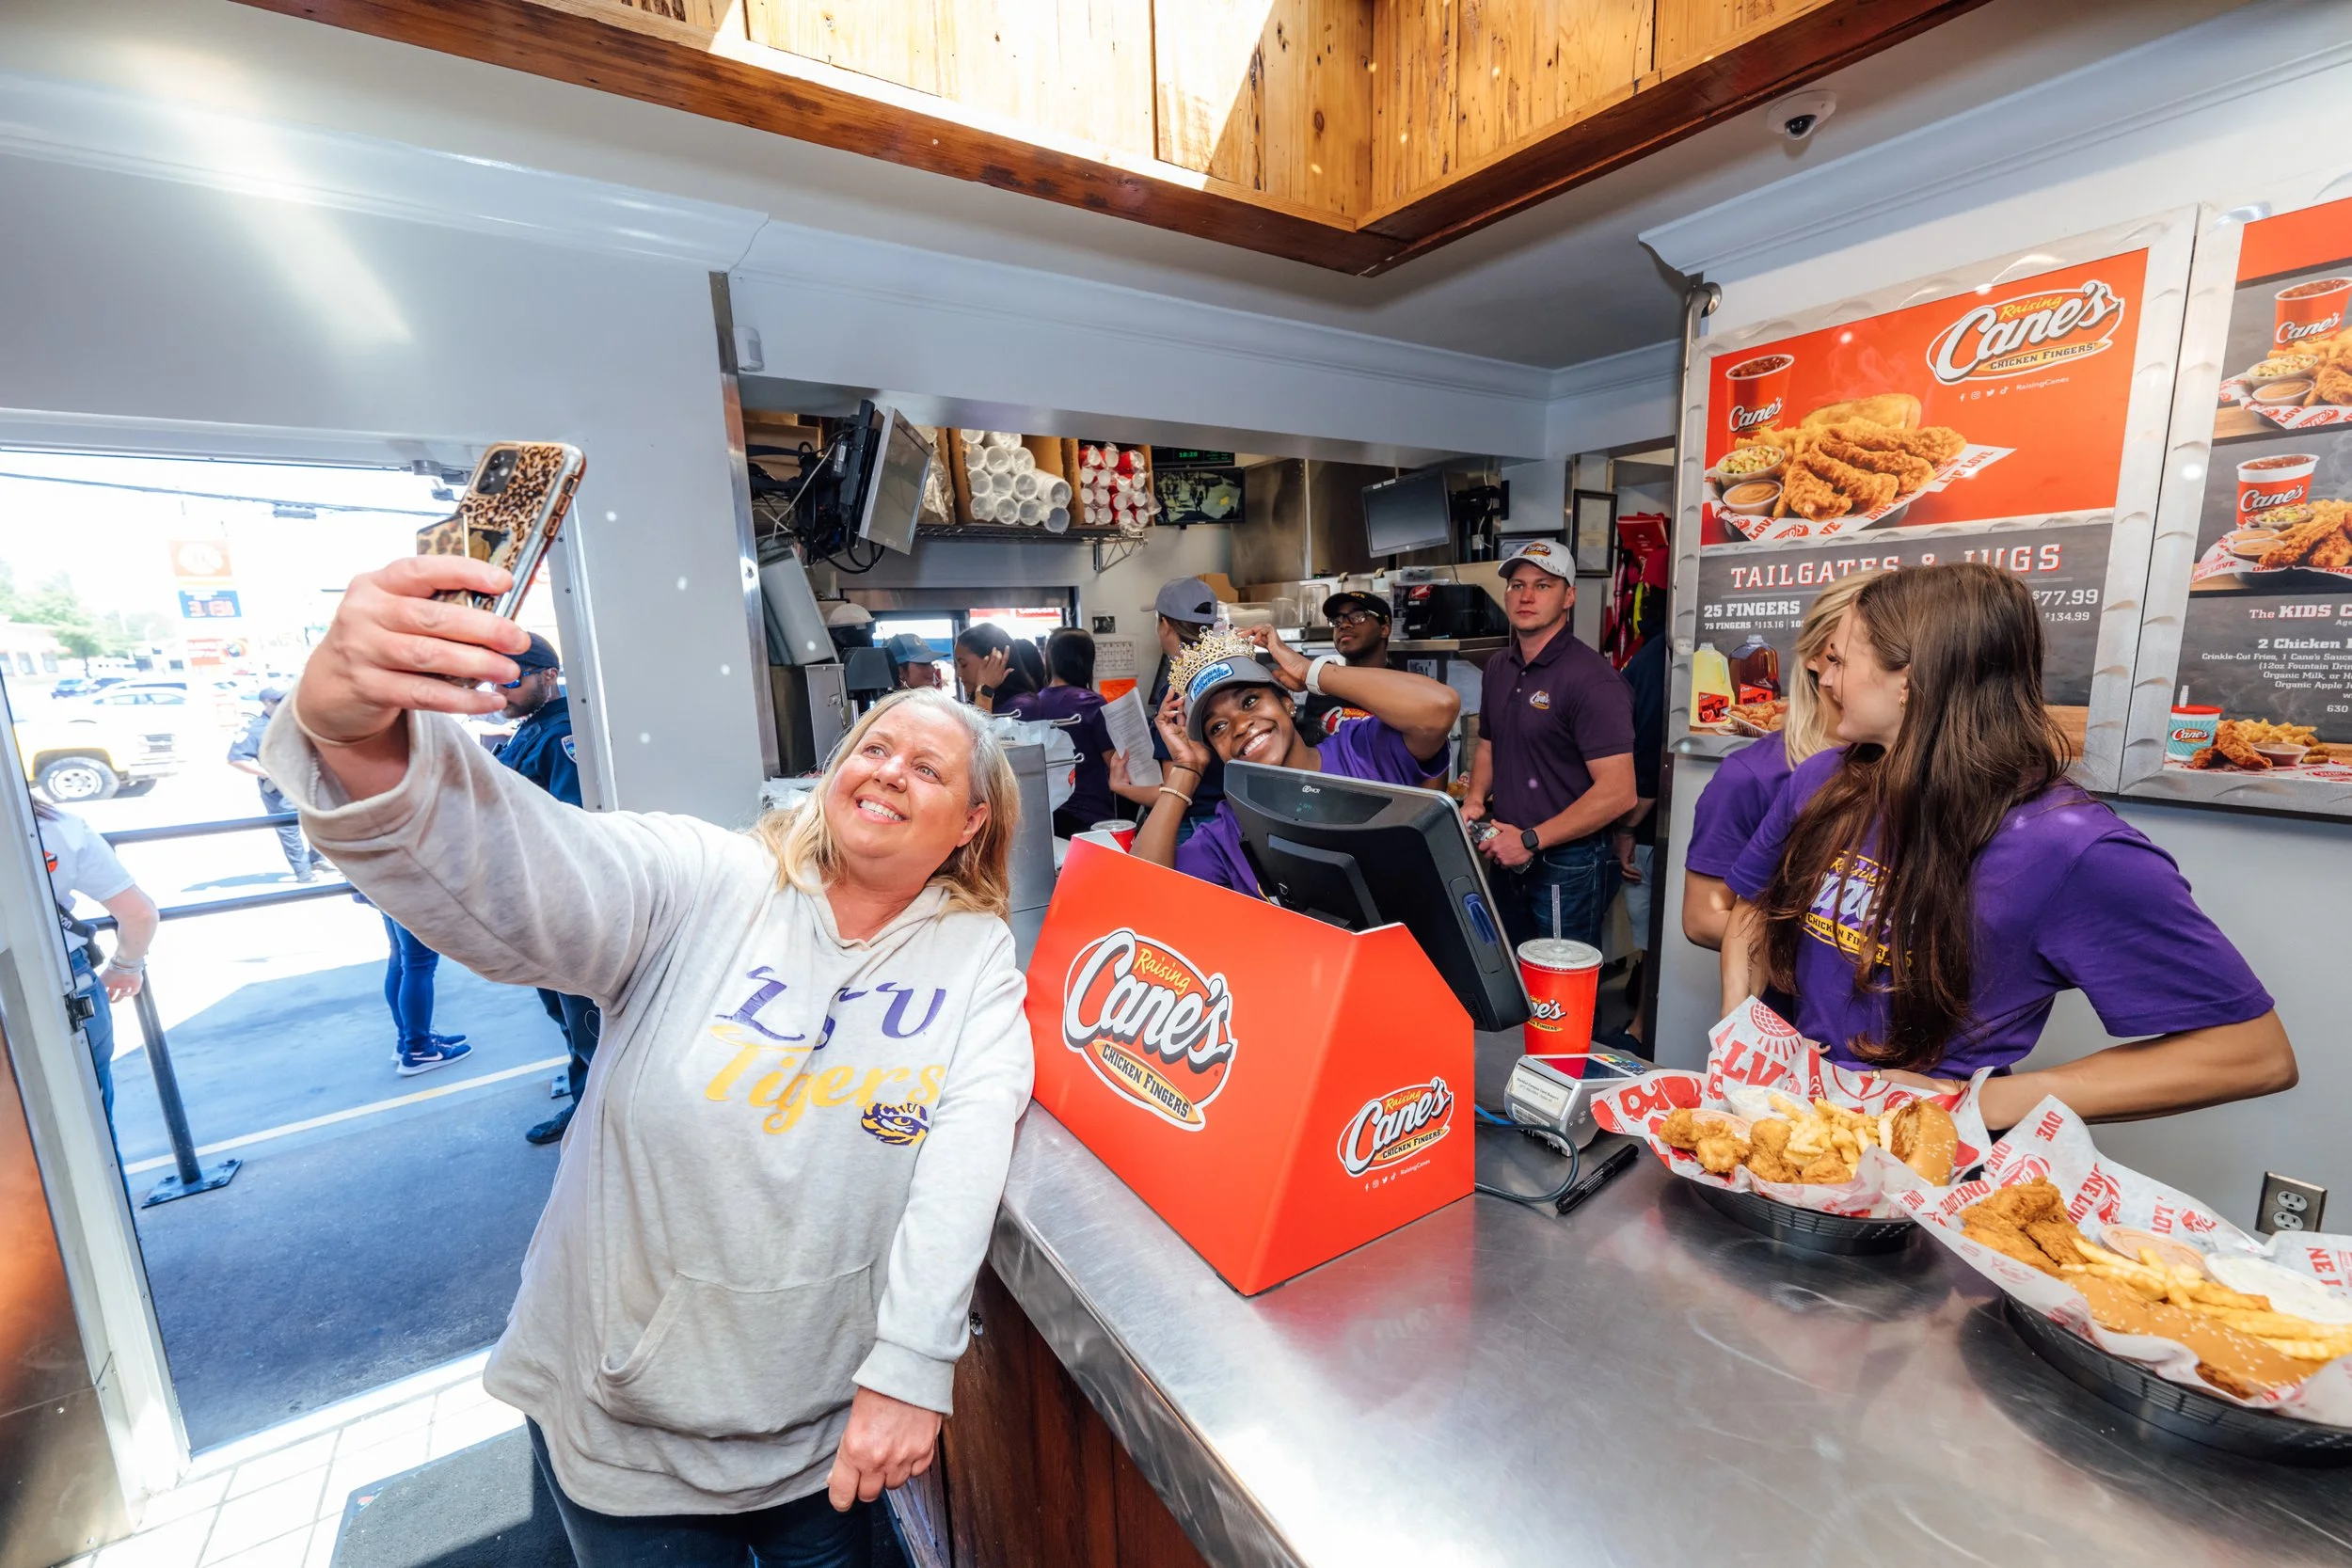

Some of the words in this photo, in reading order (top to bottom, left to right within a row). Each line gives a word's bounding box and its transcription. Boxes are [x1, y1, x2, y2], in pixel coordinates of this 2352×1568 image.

[1999, 295, 2063, 320] Raising
[1935, 282, 2122, 383] Cane's
[2276, 312, 2341, 344] Cane's
[1989, 355, 2038, 371] CHICKEN
[2042, 342, 2094, 360] FINGERS
[2016, 376, 2070, 391] RaisingCanes
[1729, 397, 1784, 433] Cane's
[2240, 484, 2304, 513] Cane's
[1704, 605, 1723, 618] 25
[1725, 600, 1801, 617] FINGERS
[2032, 588, 2099, 607] $77.99
[2249, 609, 2275, 619] The
[2279, 604, 2331, 618] KIDS
[2045, 611, 2090, 623] $134.99
[2253, 653, 2278, 661] Fries,
[2258, 639, 2268, 649] 2
[2273, 638, 2341, 649] Chicken
[2259, 662, 2285, 671] (12oz
[2287, 662, 2328, 671] Fountain
[2263, 671, 2300, 680] Organic
[2302, 672, 2327, 680] Milk,
[2275, 680, 2312, 689] Organic
[2314, 681, 2343, 689] Apple
[2171, 728, 2209, 741] Cane's
[1135, 948, 1191, 996] Raising
[1066, 931, 1233, 1074] Cane's
[705, 1023, 946, 1135] Tigers
[1102, 1044, 1142, 1085] CHICKEN
[1143, 1073, 1189, 1118] FINGERS
[1385, 1090, 1422, 1112] Raising
[1345, 1079, 1452, 1174] Cane's
[1382, 1142, 1412, 1159] CHICKEN
[1414, 1130, 1441, 1147] FINGERS
[1400, 1160, 1431, 1175] RaisingCanes
